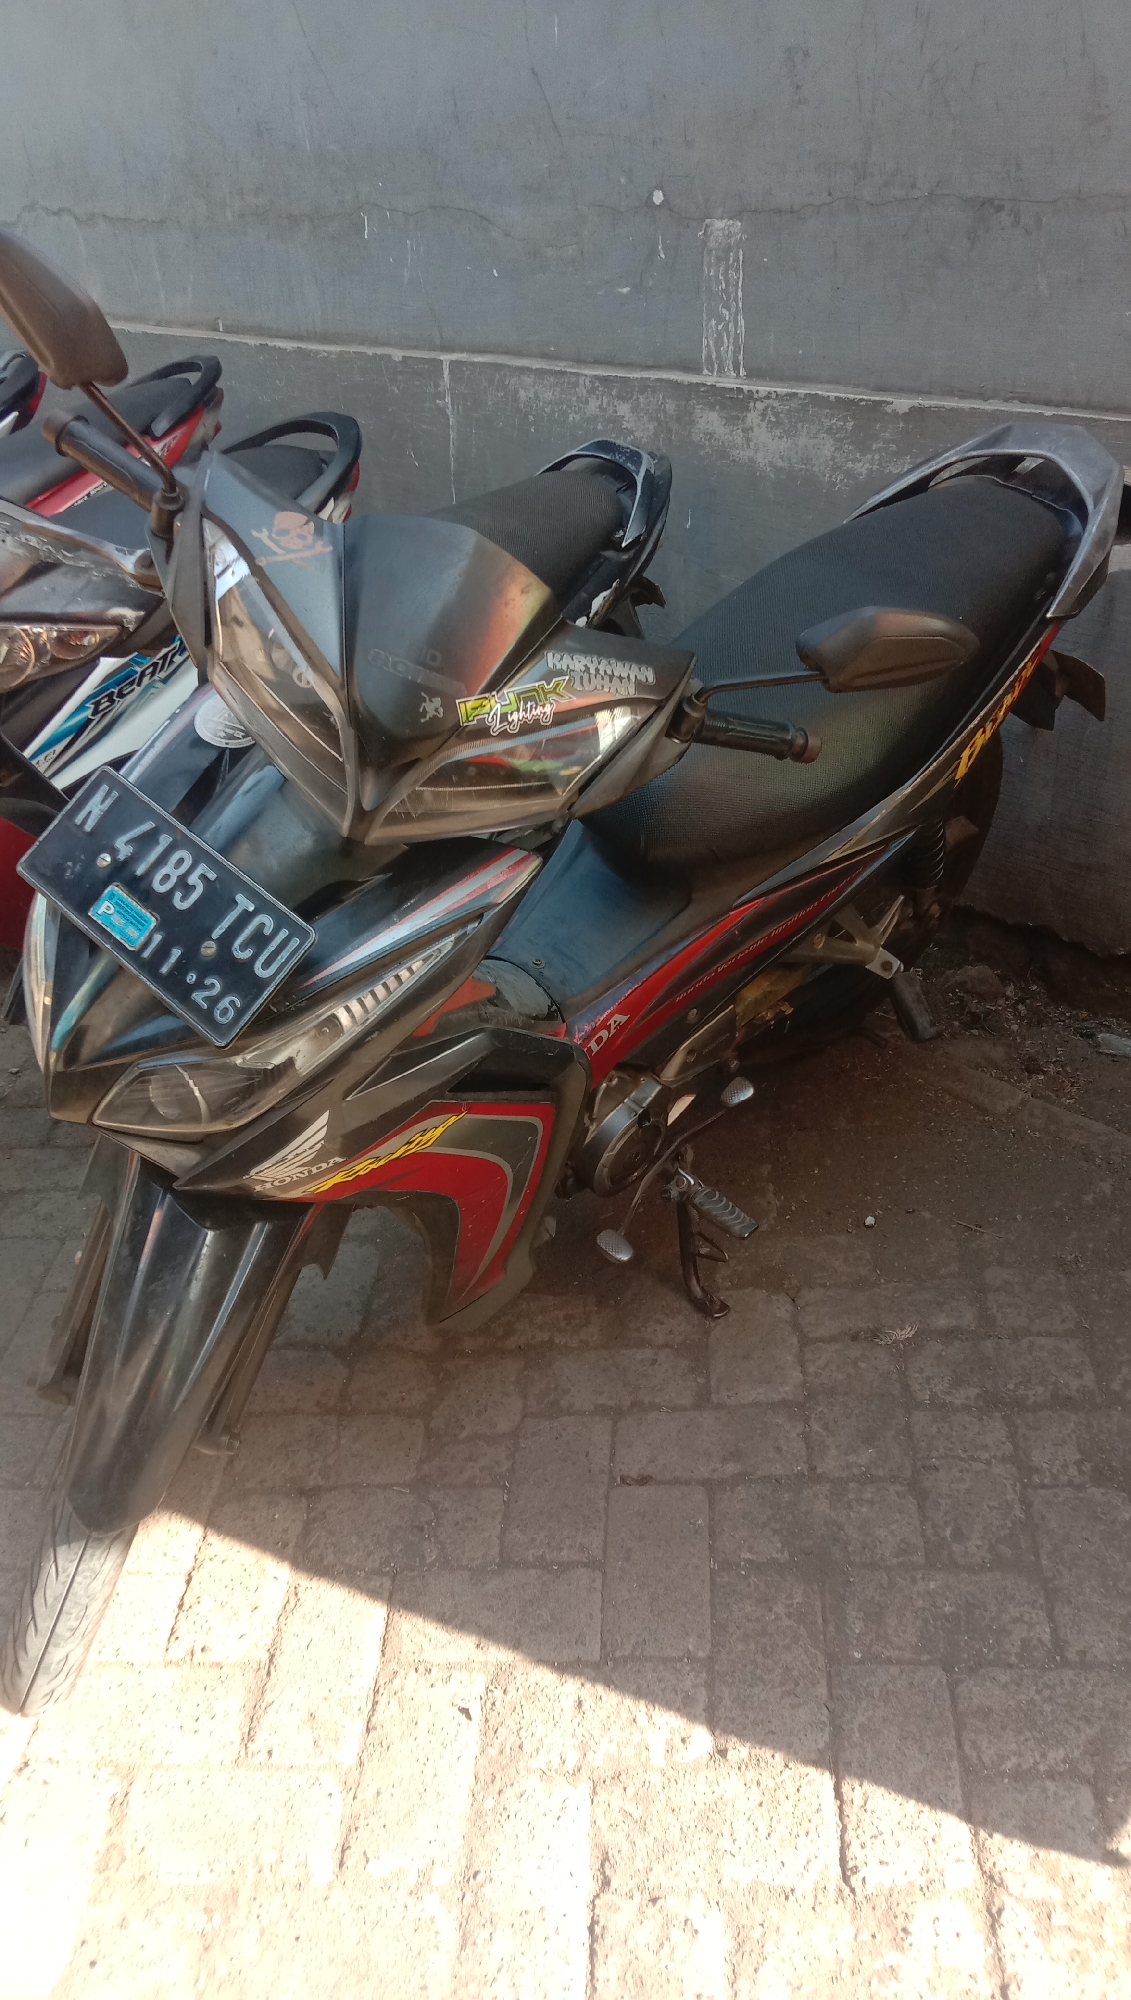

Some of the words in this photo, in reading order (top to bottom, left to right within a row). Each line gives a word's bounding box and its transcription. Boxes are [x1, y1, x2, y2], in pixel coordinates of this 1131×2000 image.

[545, 650, 655, 685] KARYAWAN
[487, 699, 554, 734] Lighting
[74, 784, 119, 833] N
[113, 820, 218, 911] 4185
[210, 893, 301, 979] TCU
[253, 1155, 348, 1193] HONDA
